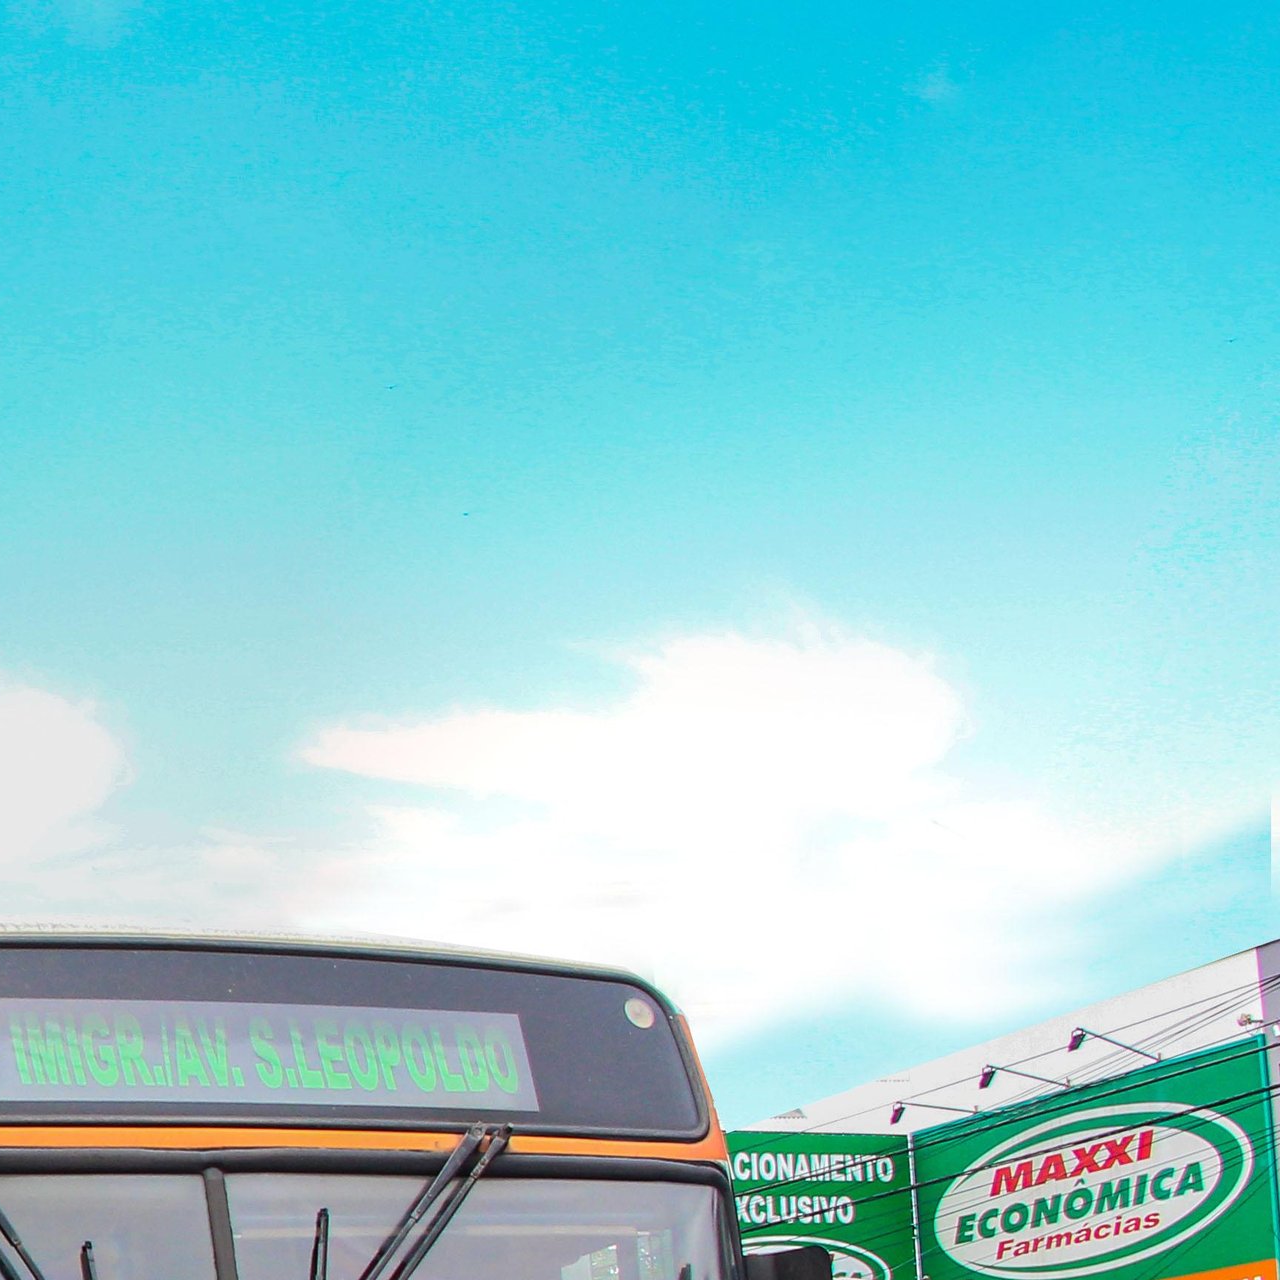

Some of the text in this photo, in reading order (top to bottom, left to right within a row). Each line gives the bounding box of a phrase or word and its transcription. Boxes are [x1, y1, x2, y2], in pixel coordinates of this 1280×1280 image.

[730, 1152, 894, 1183] CIONAMENTO
[989, 1129, 1154, 1197] MAXXI
[735, 1194, 855, 1224] XCLUSIVO
[954, 1161, 1205, 1245] ECONÔMICA
[996, 1212, 1160, 1260] Farmácias
